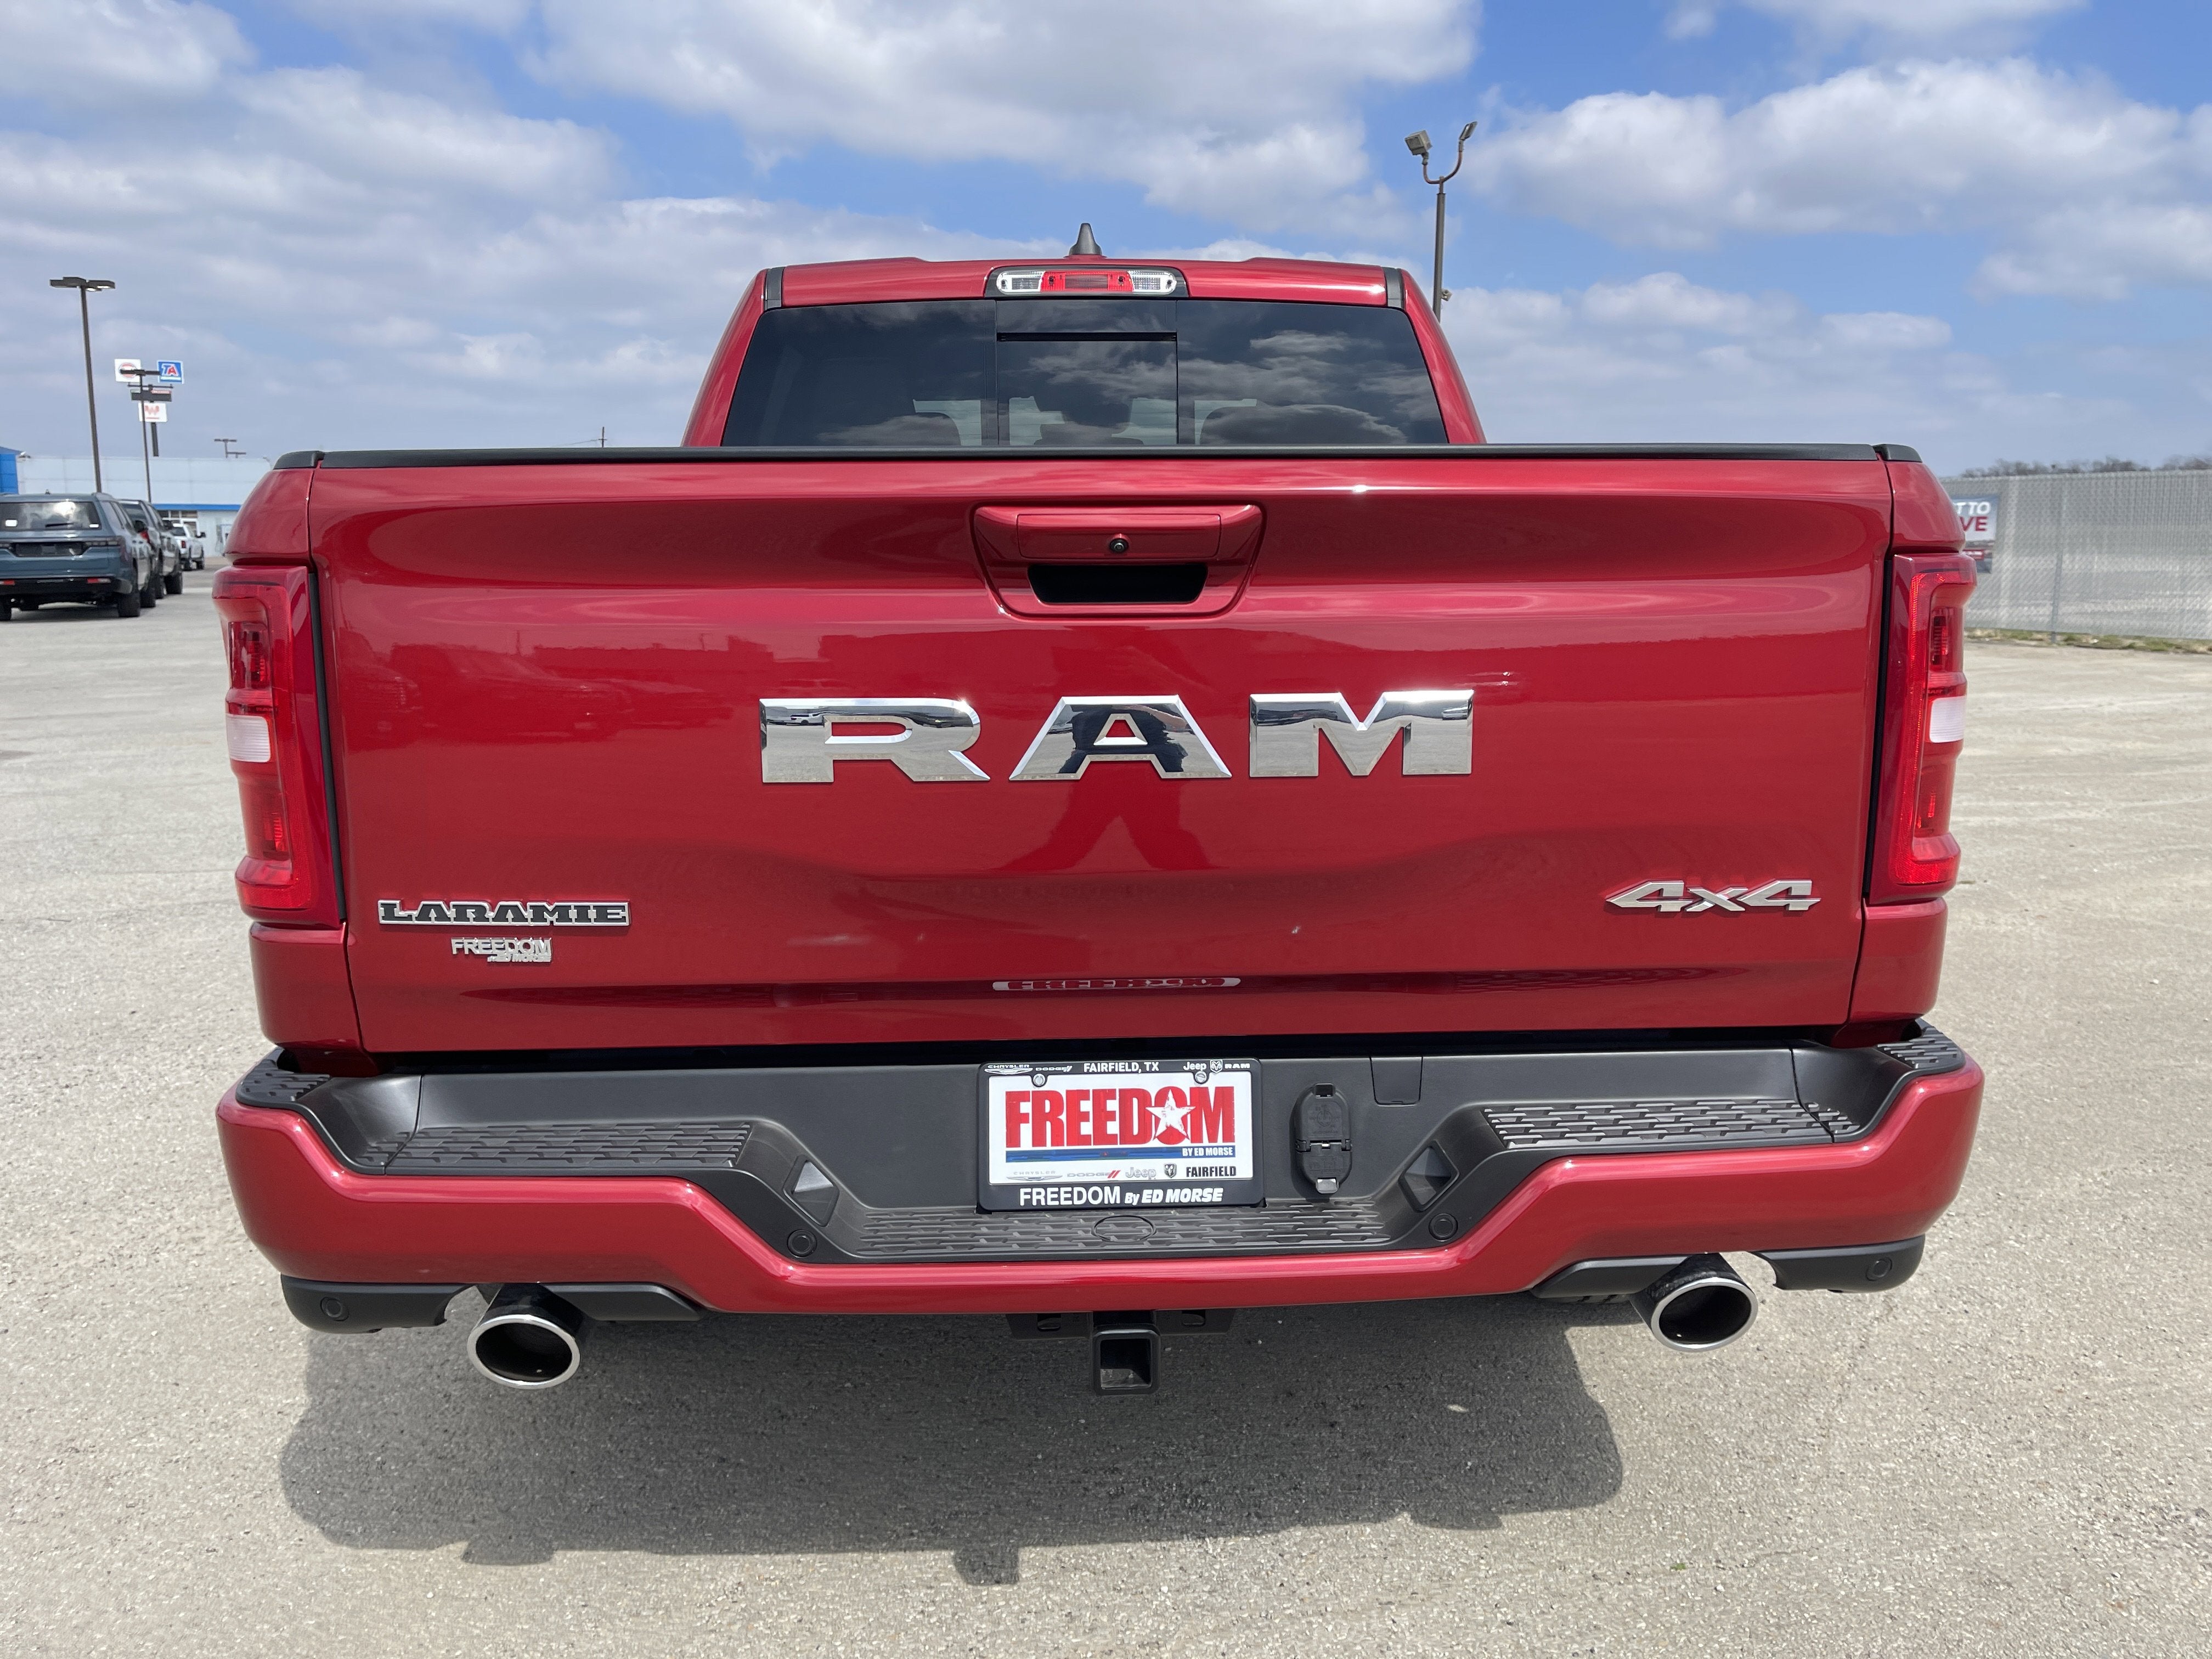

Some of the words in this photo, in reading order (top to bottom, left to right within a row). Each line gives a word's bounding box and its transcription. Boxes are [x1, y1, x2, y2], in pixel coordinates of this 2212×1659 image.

[162, 364, 179, 376] TA
[759, 690, 1475, 783] RAM
[378, 900, 630, 926] LARAMIE
[451, 937, 552, 955] FREEDOM
[1084, 1062, 1142, 1074] FAIRFIELD,
[1144, 1062, 1159, 1071] TX
[1183, 1061, 1206, 1071] Jeep
[1006, 1086, 1235, 1148] FREEDOM
[1182, 1148, 1193, 1156] BY
[1194, 1148, 1204, 1156] ED
[1206, 1147, 1233, 1156] MORSE
[1125, 1167, 1156, 1180] Jeep
[1186, 1166, 1237, 1177] FAIRFIELD
[1020, 1186, 1120, 1206] FREEDOM
[1125, 1192, 1139, 1205] By
[1142, 1189, 1164, 1204] ED
[1165, 1188, 1224, 1203] MORSE
